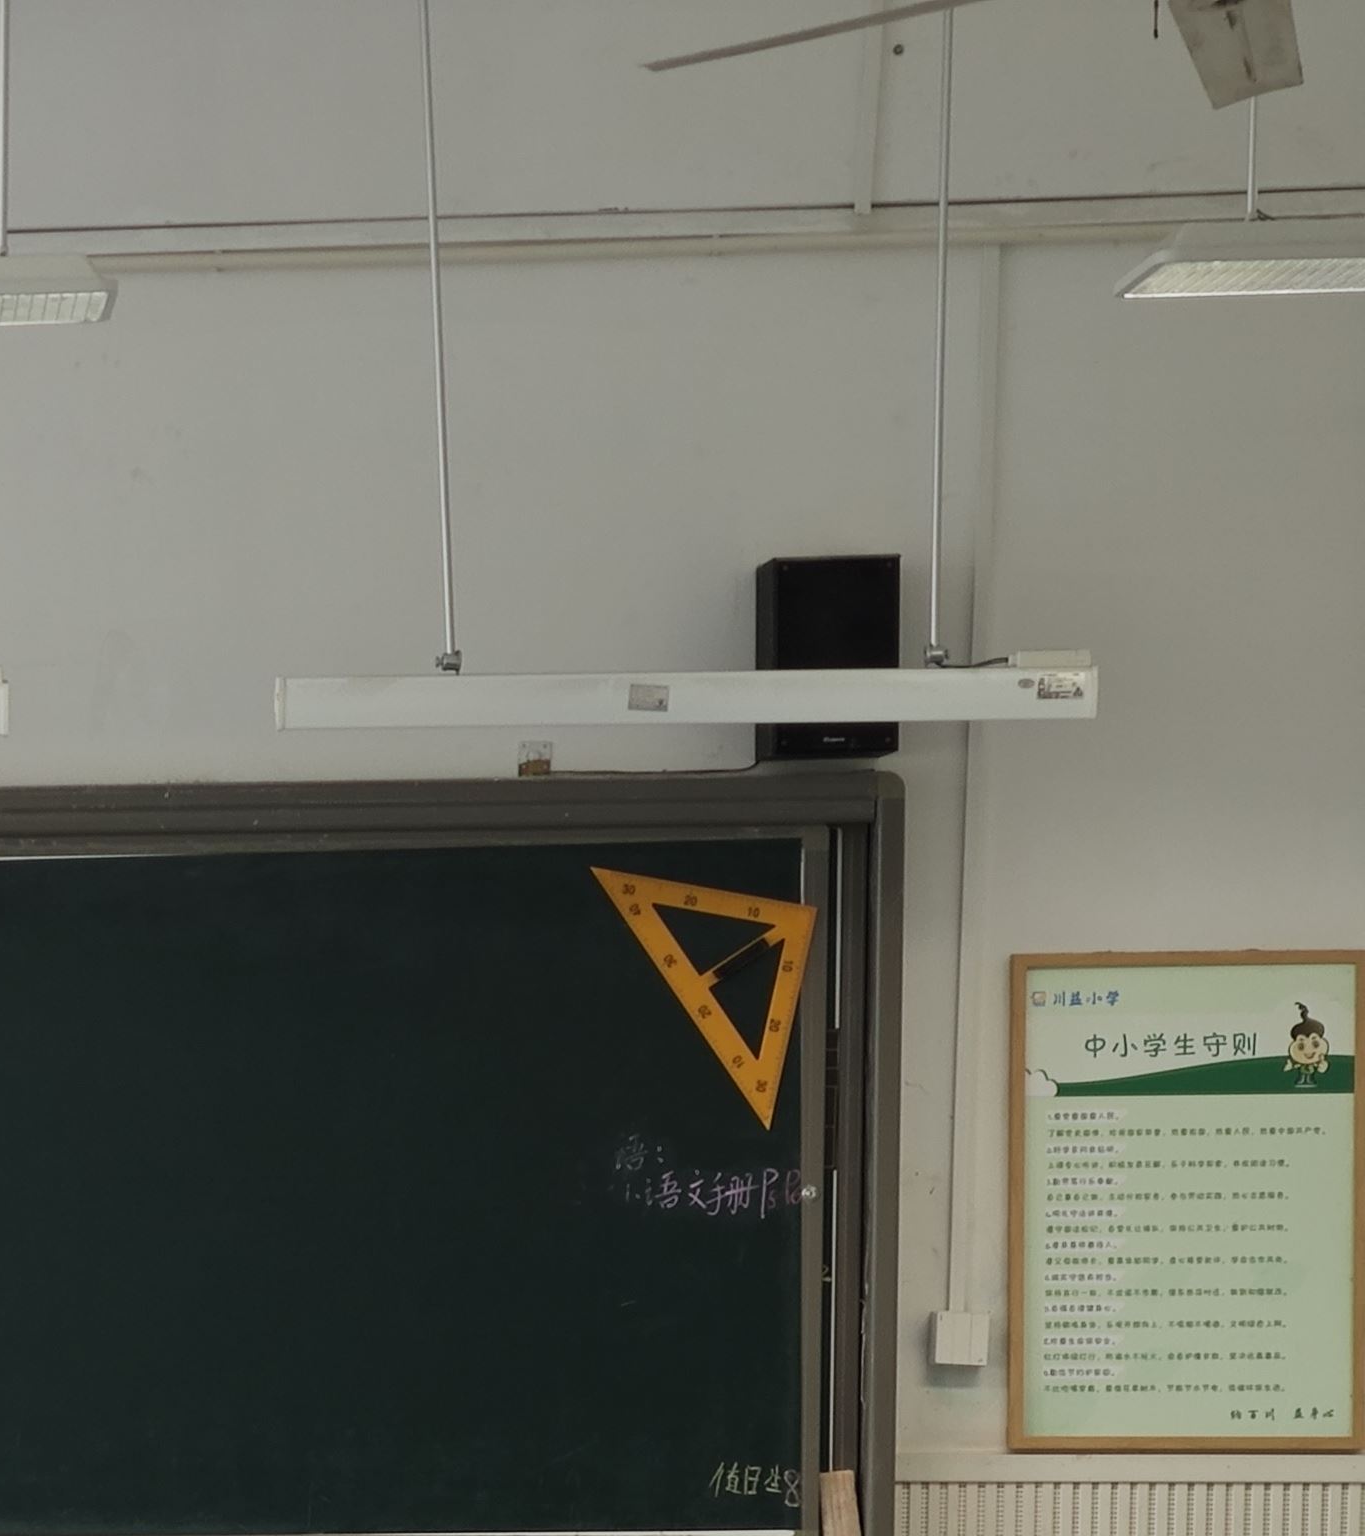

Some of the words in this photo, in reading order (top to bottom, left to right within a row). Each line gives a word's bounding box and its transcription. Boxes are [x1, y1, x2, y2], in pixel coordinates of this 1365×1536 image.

[1084, 1032, 1257, 1058] 中小学生守则
